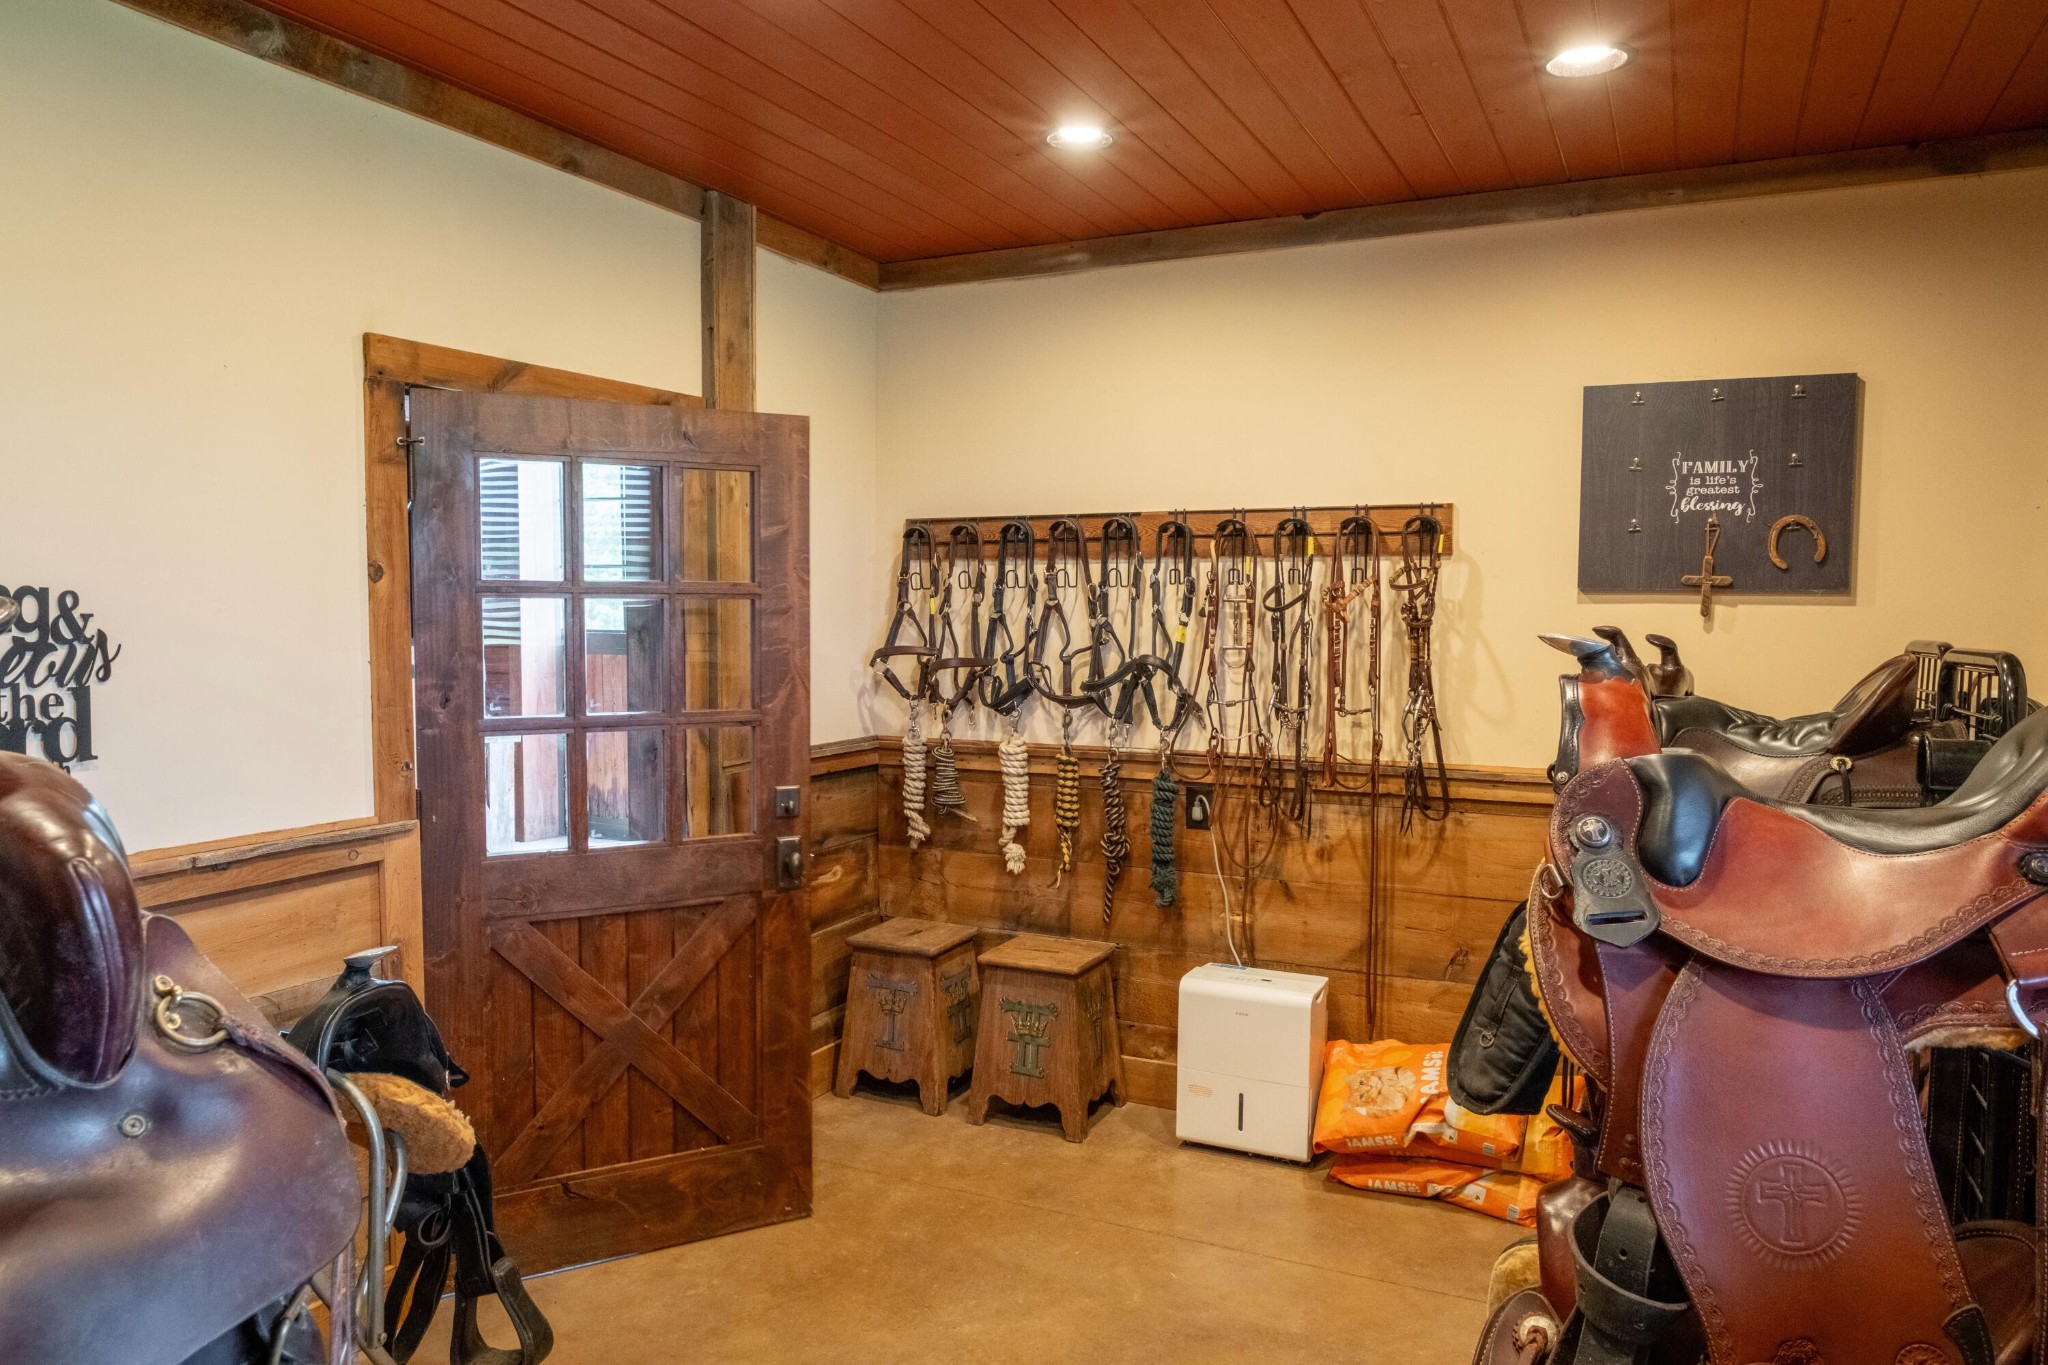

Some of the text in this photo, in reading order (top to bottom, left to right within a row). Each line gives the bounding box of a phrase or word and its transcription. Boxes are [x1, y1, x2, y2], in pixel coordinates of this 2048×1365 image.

[1682, 460, 1749, 474] FAMILY
[1689, 475, 1737, 485] is life's
[1686, 485, 1741, 497] greatest
[1680, 496, 1746, 516] blessing
[1345, 1135, 1385, 1149] IAMS
[1367, 1178, 1407, 1193] IAMS
